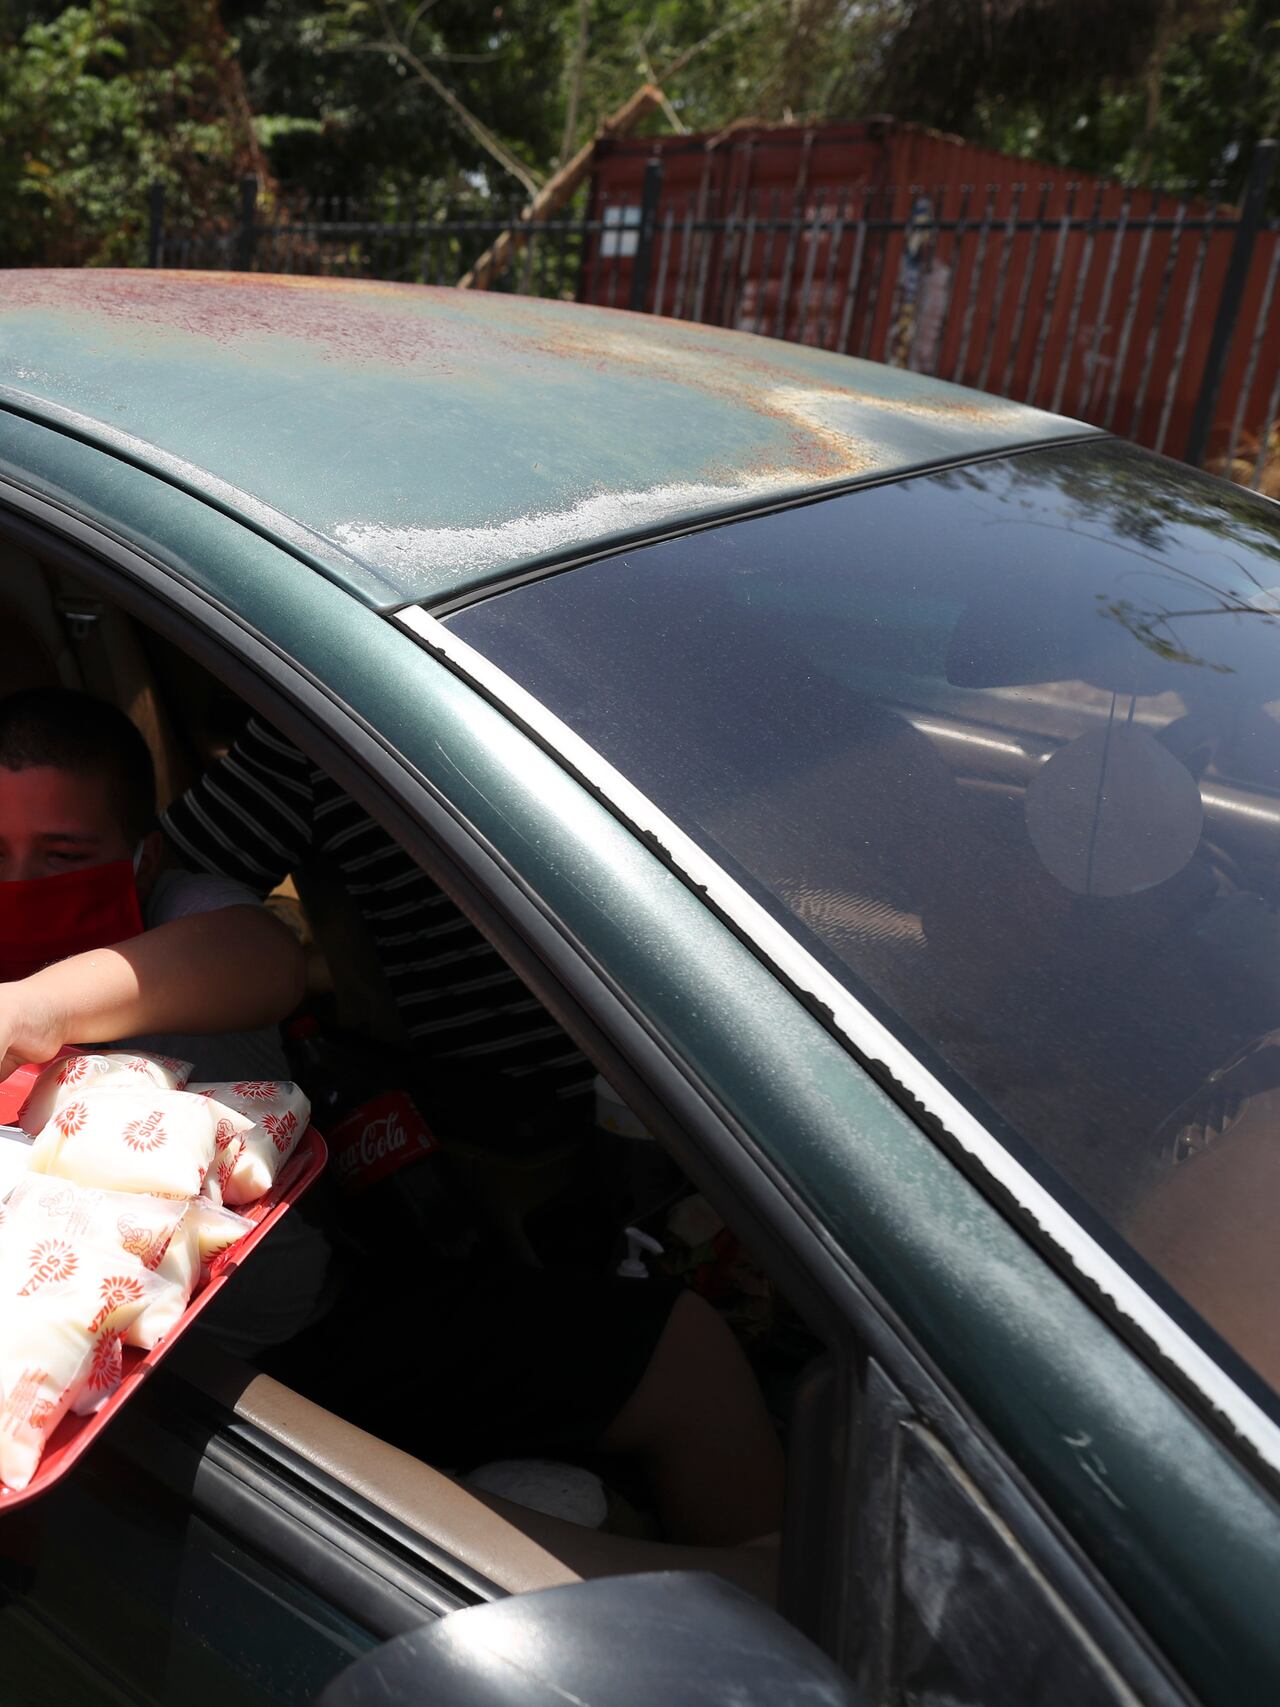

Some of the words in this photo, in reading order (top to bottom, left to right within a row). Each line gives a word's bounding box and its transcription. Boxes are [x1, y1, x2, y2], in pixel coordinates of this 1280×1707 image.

[139, 1110, 166, 1137] SUIZA
[276, 1109, 298, 1136] SUIZA
[17, 1254, 61, 1297] SUIZA
[87, 1289, 126, 1333] SUIZA
